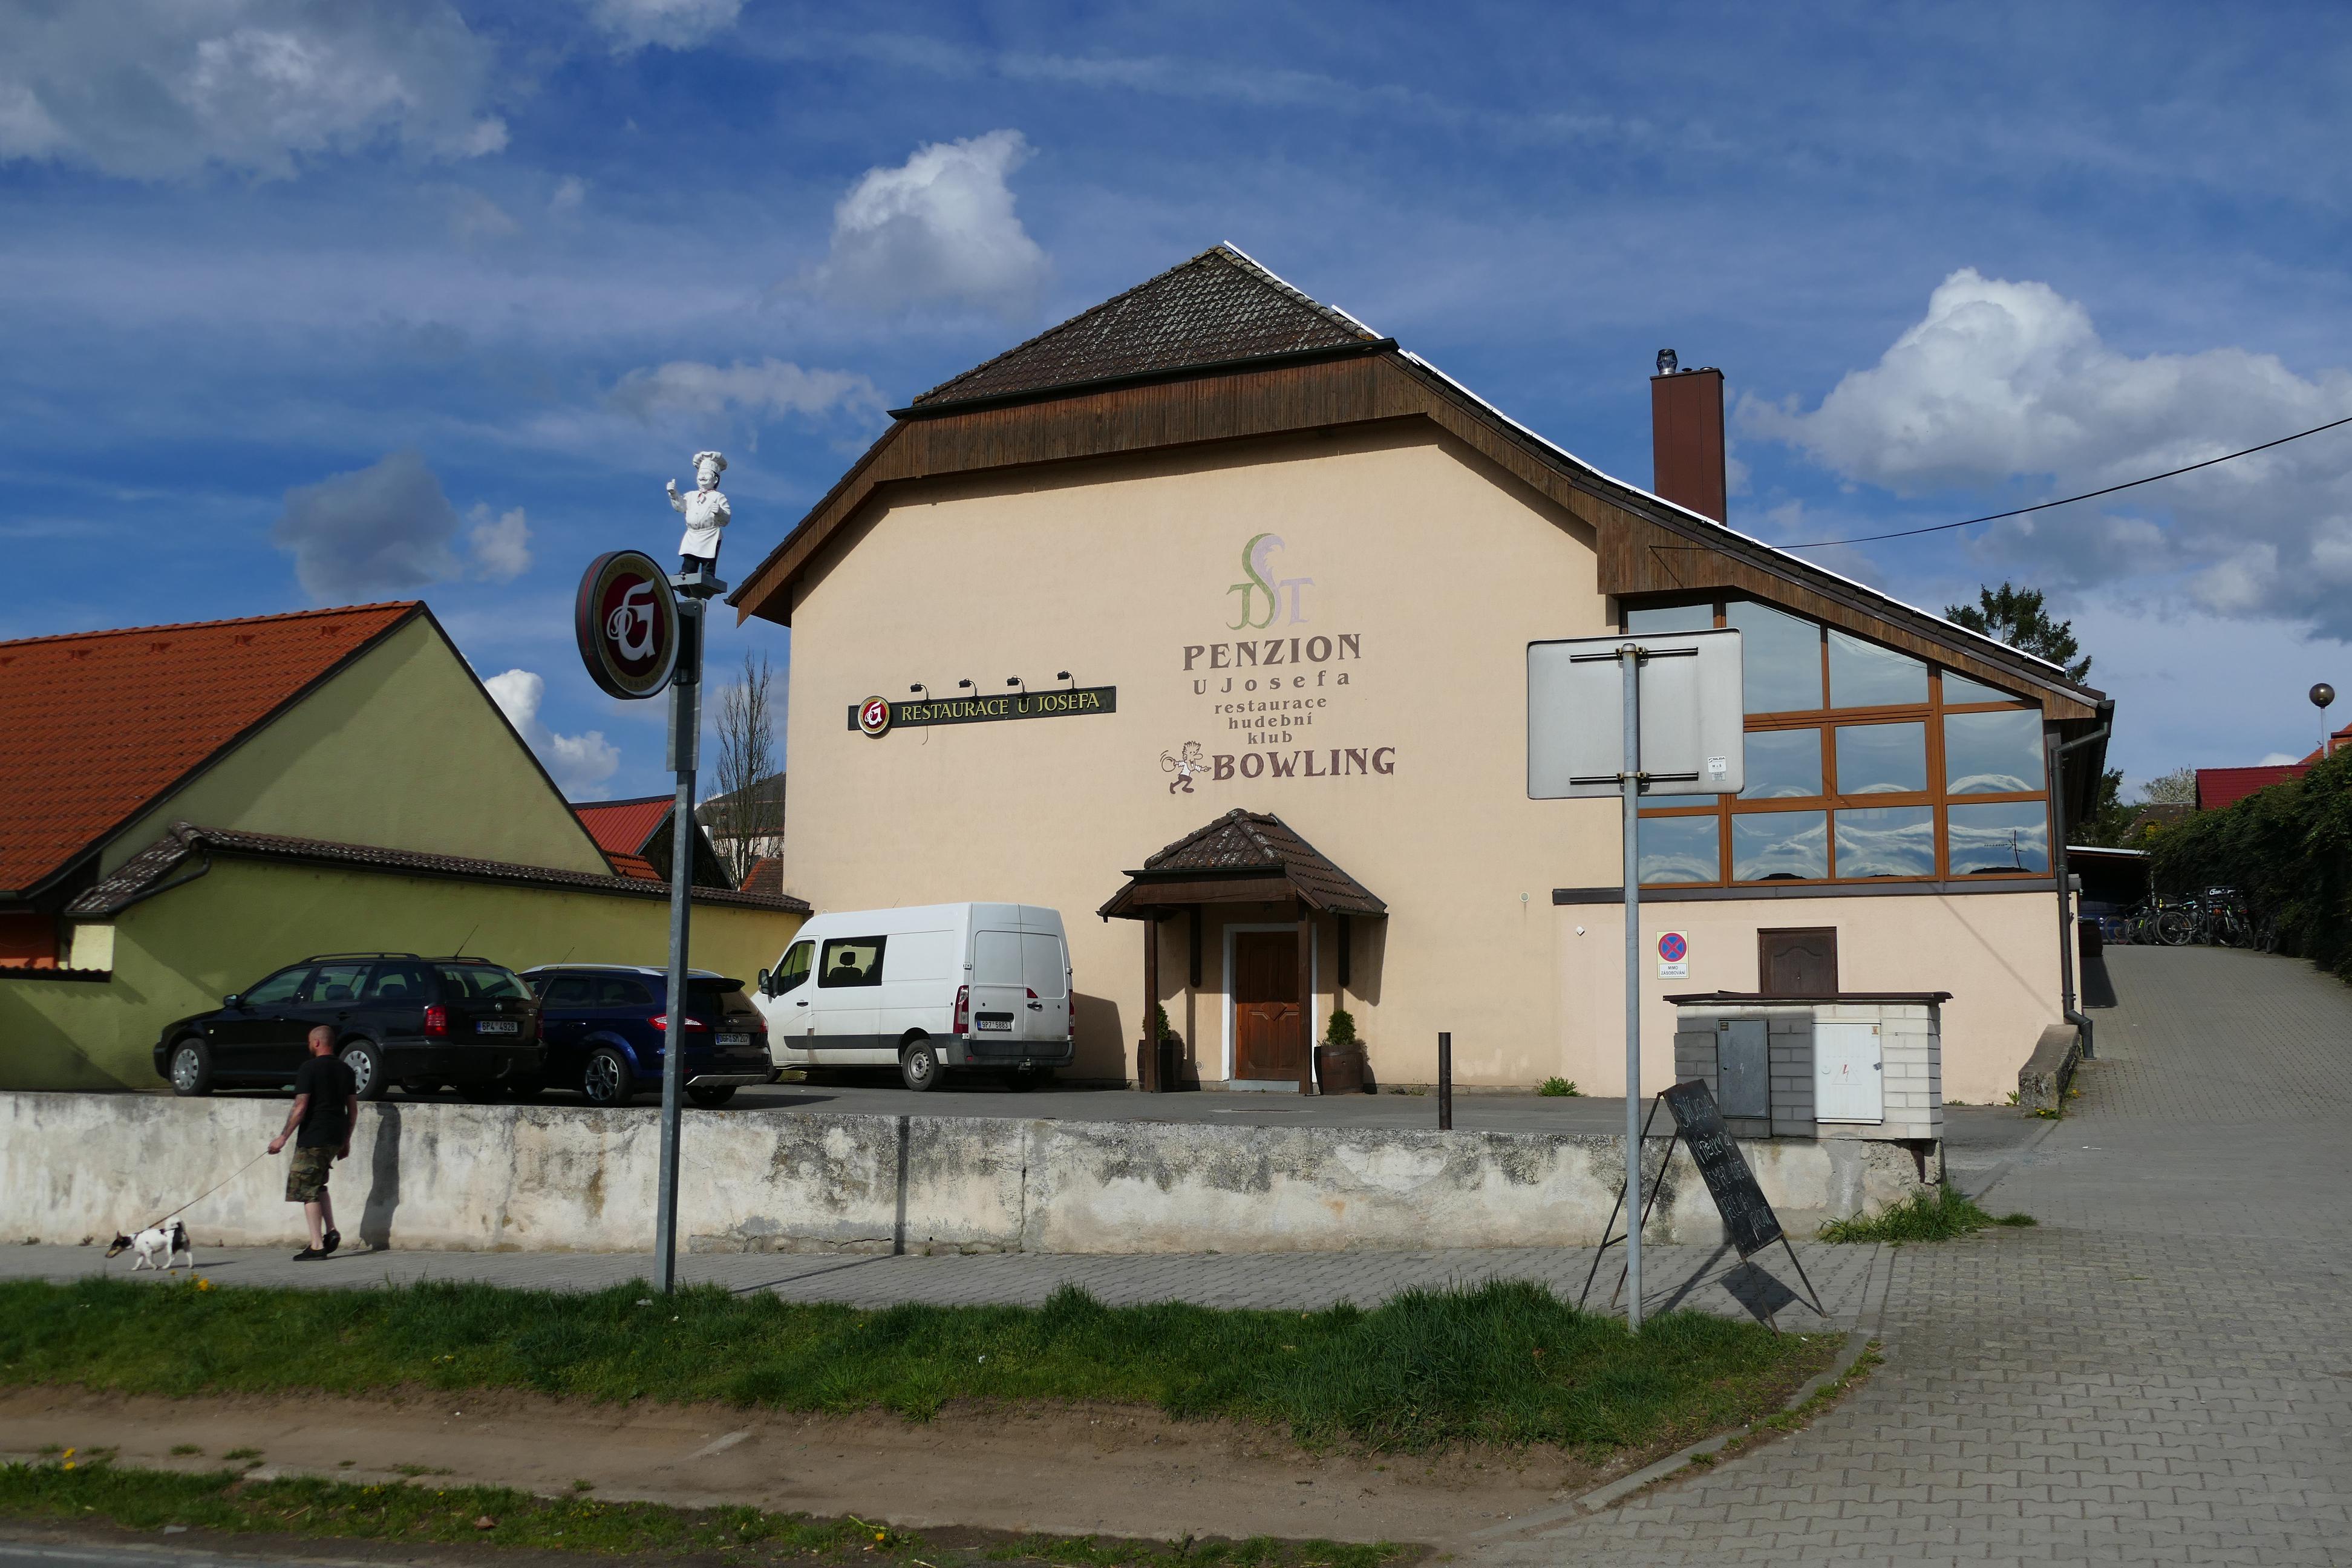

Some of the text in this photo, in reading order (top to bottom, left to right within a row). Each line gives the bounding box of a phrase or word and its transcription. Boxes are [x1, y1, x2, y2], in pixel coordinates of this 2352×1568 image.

[1183, 633, 1362, 671] PENZION
[901, 699, 1008, 721] RESTAURACE
[1018, 697, 1031, 713] U
[1037, 693, 1100, 713] JOSEFA
[1214, 697, 1327, 714] restaurace
[1228, 712, 1313, 730] hudební
[1247, 731, 1293, 745] klub
[1212, 746, 1396, 782] BOWLING
[482, 1022, 494, 1031] 6P4
